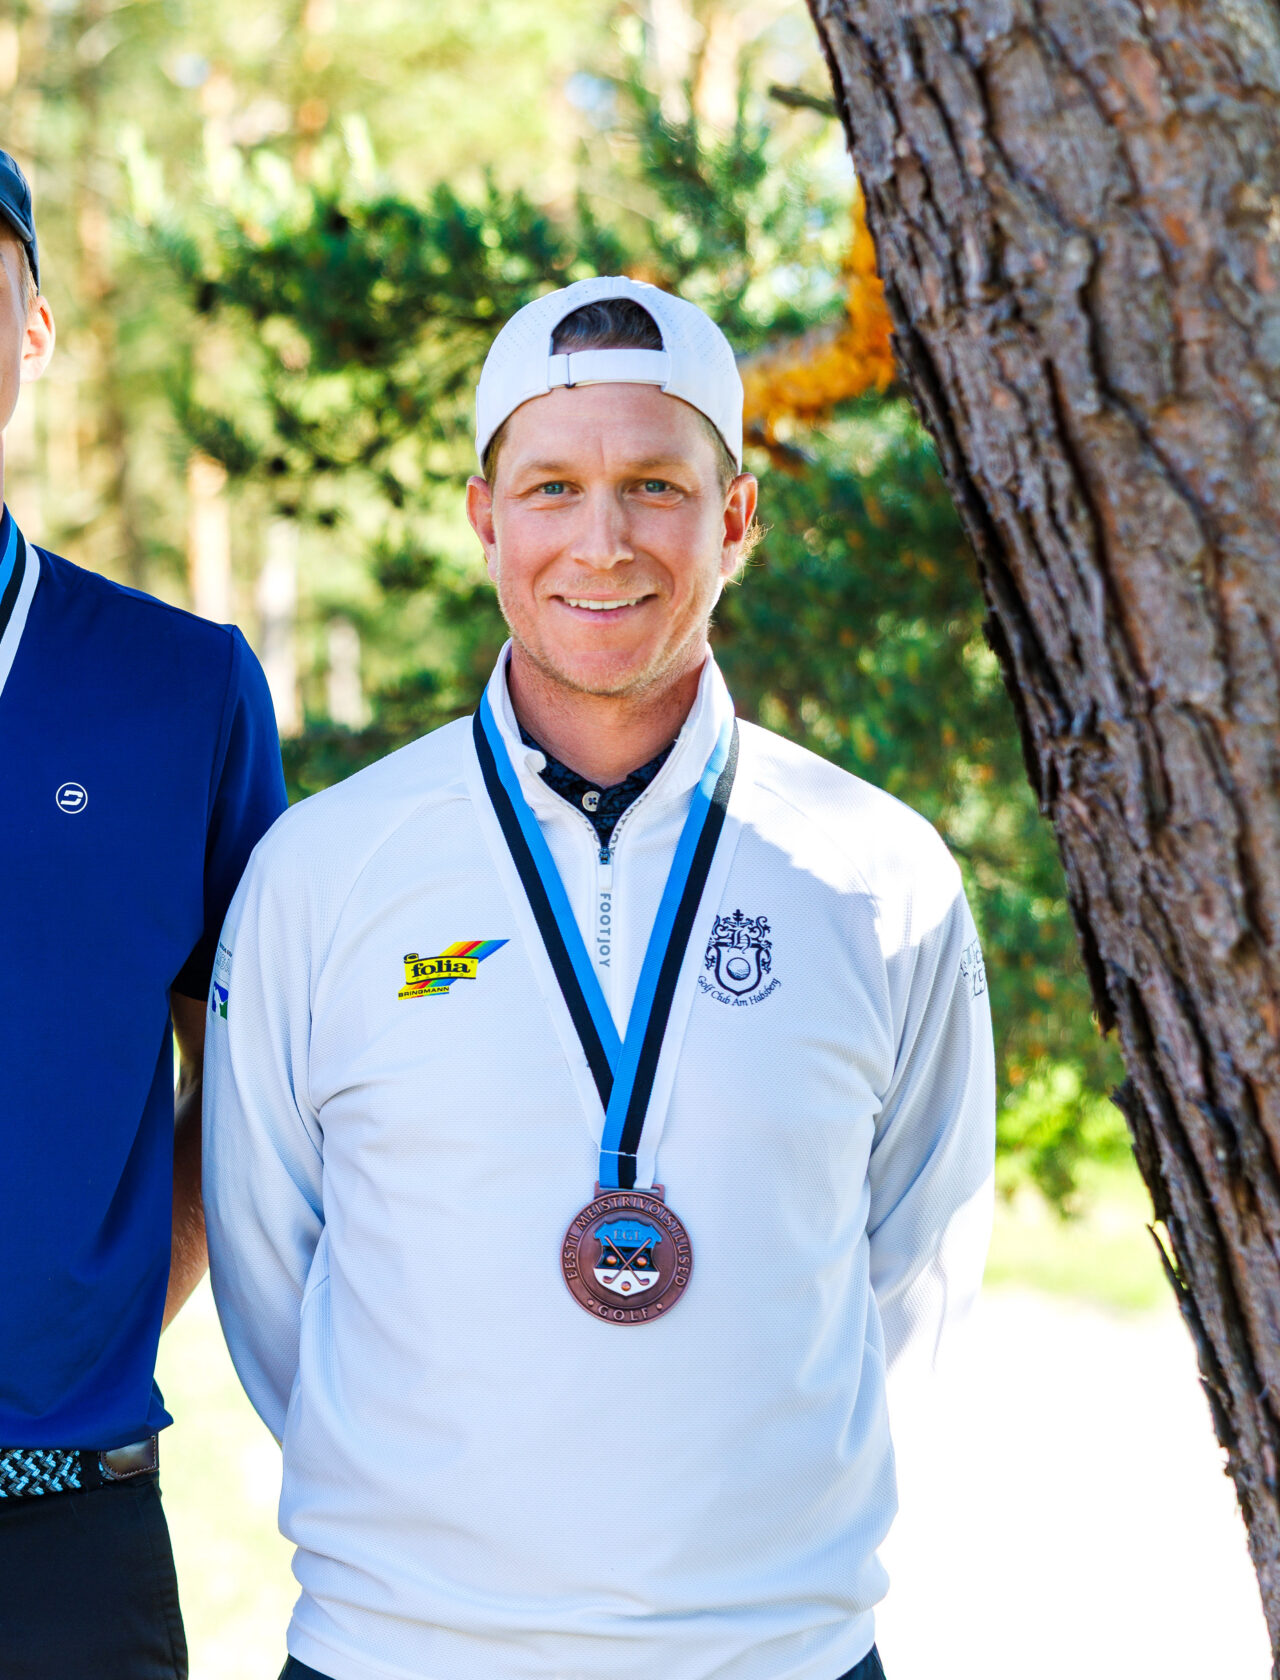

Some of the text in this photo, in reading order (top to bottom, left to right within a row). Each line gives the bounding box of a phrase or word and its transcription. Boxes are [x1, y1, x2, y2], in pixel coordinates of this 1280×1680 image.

[597, 893, 611, 967] FOOTJOY
[411, 960, 470, 978] folia
[398, 986, 449, 998] BRINGMANN
[698, 975, 715, 994] Golf
[710, 990, 731, 1005] Club
[732, 998, 748, 1007] Am
[564, 1234, 579, 1280] EESTI
[598, 1305, 649, 1321] GOLF
